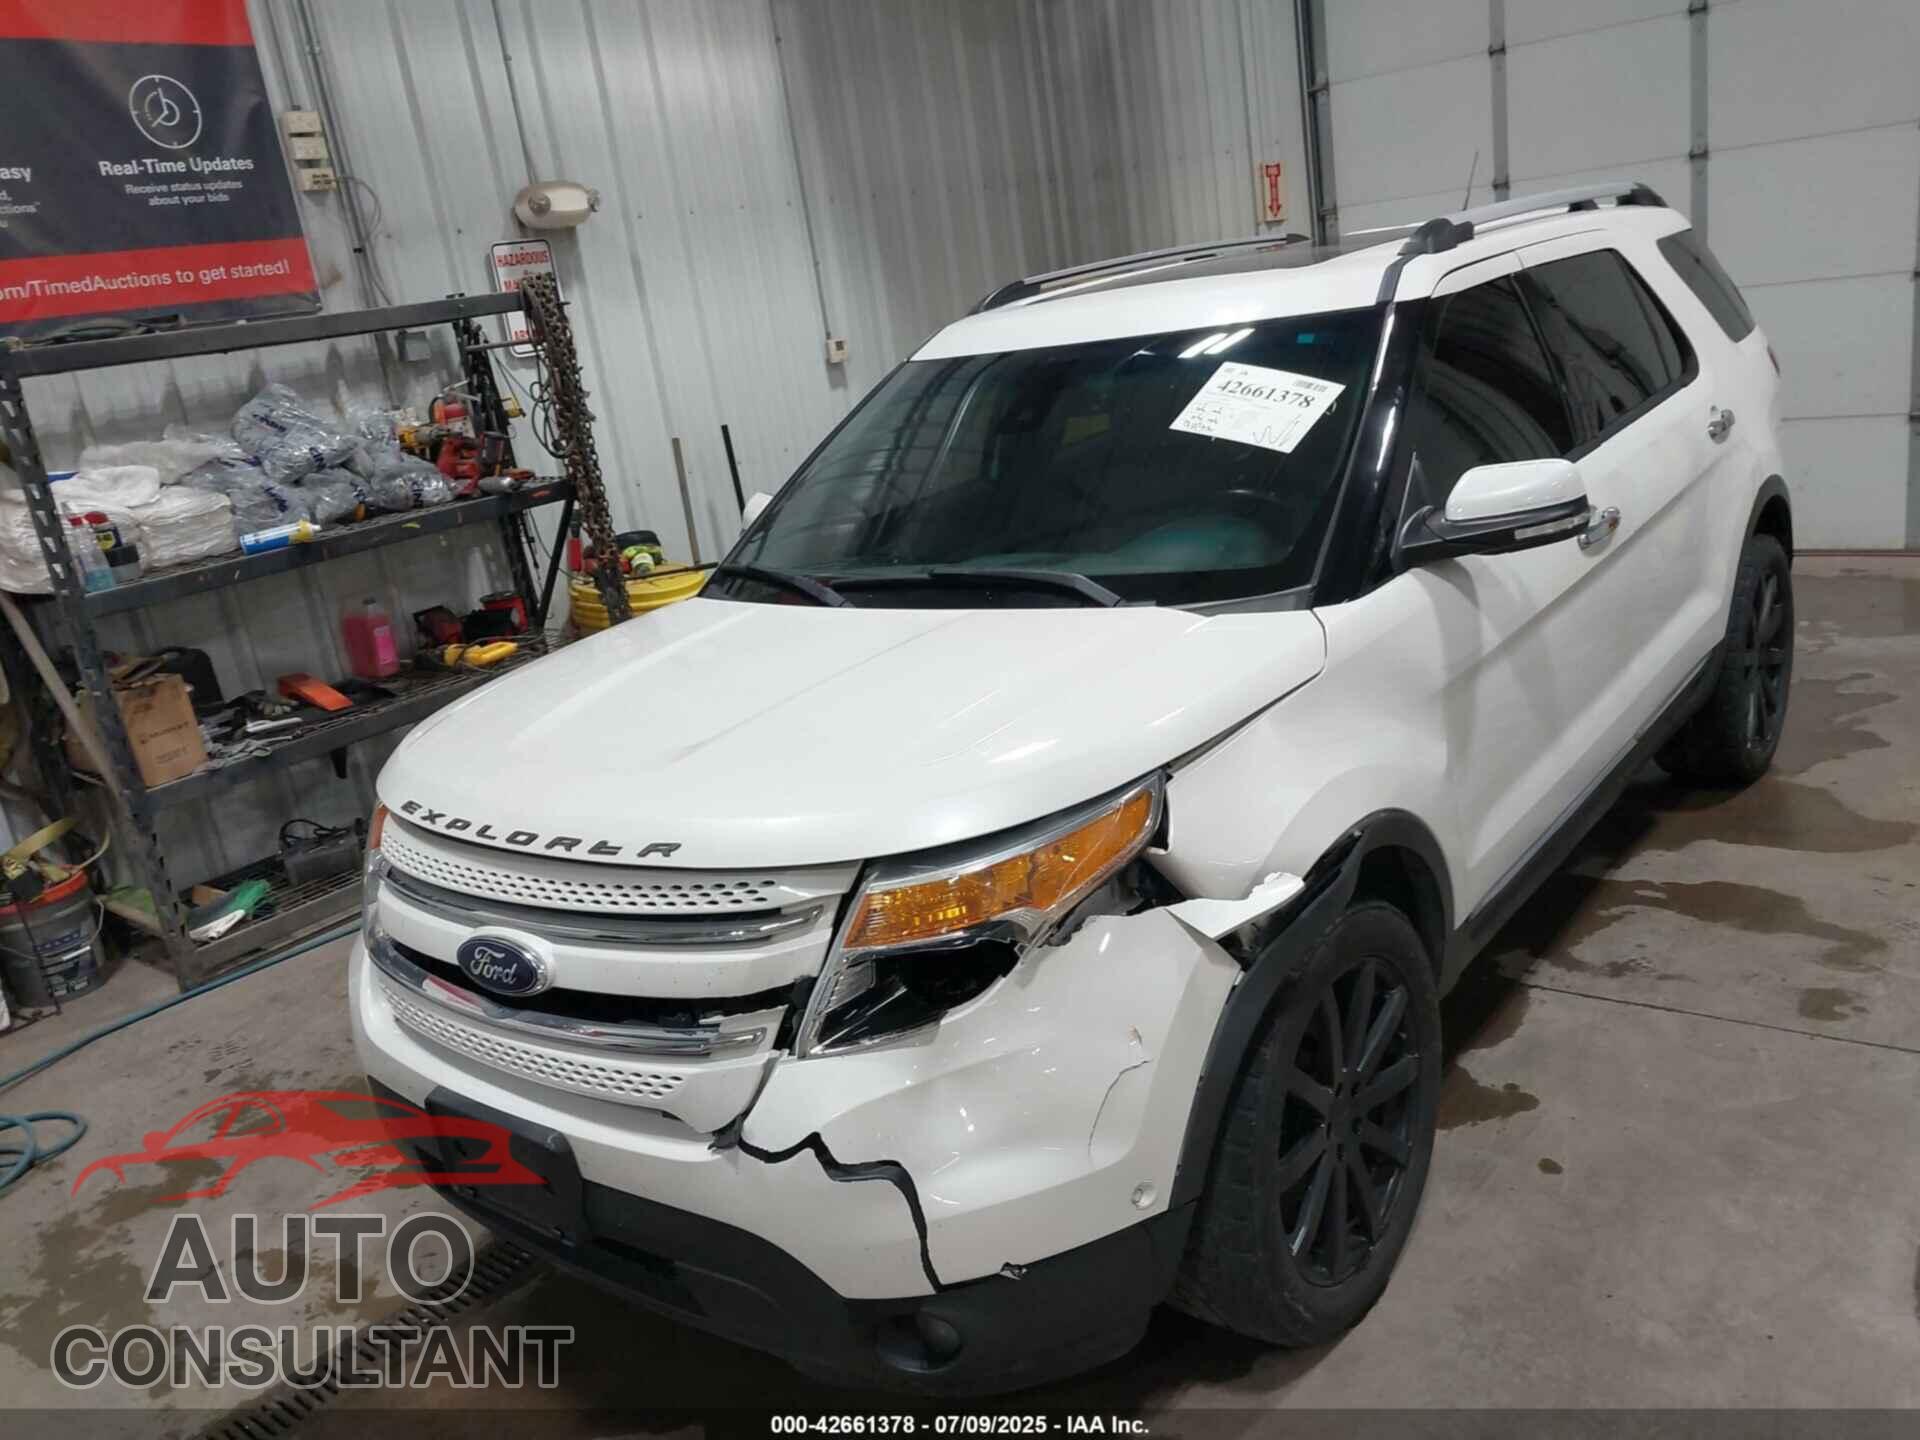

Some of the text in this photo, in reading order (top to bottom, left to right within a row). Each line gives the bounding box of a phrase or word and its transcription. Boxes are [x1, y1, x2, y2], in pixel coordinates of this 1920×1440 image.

[98, 156, 254, 176] Real-Time Updates
[125, 180, 243, 194] Receive status updates
[148, 194, 180, 205] about
[182, 194, 204, 205] your
[496, 251, 549, 267] HAZARDOUS
[176, 269, 194, 284] to
[199, 265, 226, 285] get
[230, 259, 290, 277] started!
[1217, 379, 1316, 409] 42661378
[401, 800, 682, 858] EXPLORER
[469, 946, 517, 986] Ford
